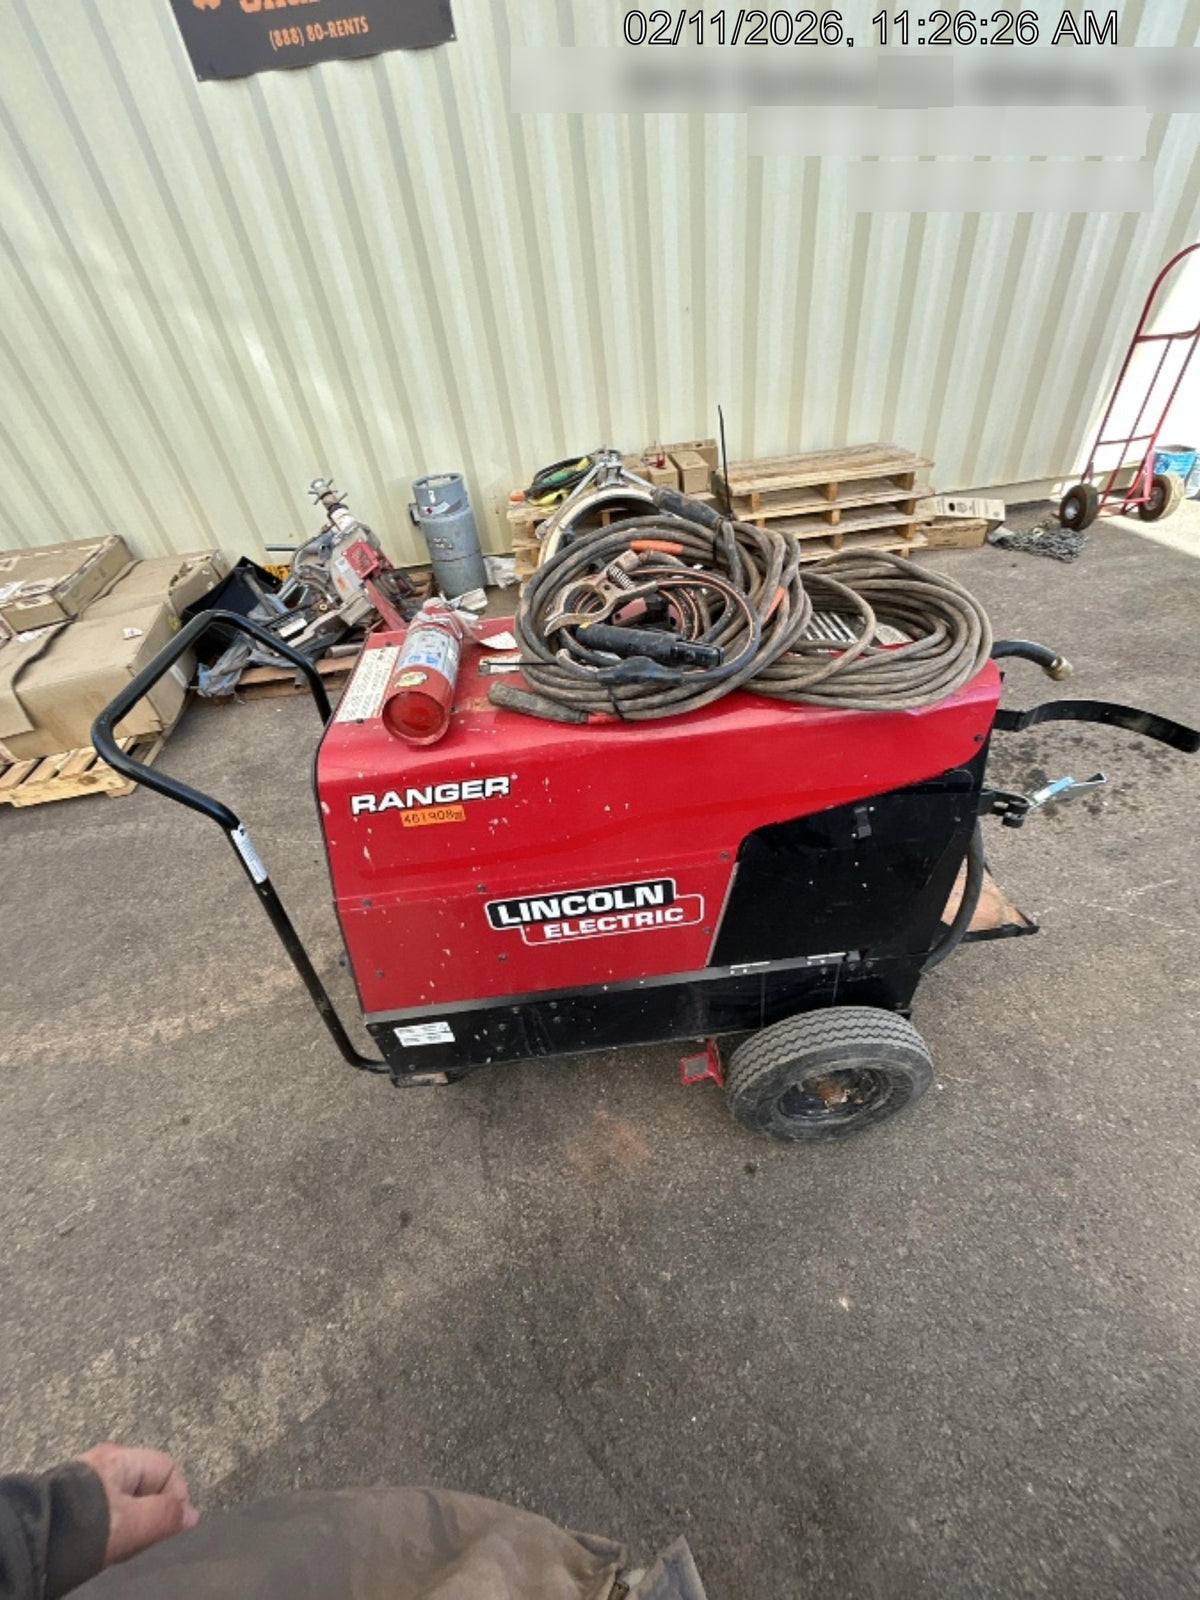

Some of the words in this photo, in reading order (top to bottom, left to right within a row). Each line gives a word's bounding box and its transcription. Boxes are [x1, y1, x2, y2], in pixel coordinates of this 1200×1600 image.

[269, 26, 305, 52] (888)
[305, 16, 369, 42] 80-RENTS
[351, 776, 510, 815] RANGER
[497, 884, 665, 925] LINCOLN
[543, 908, 684, 940] ELECTRIC
